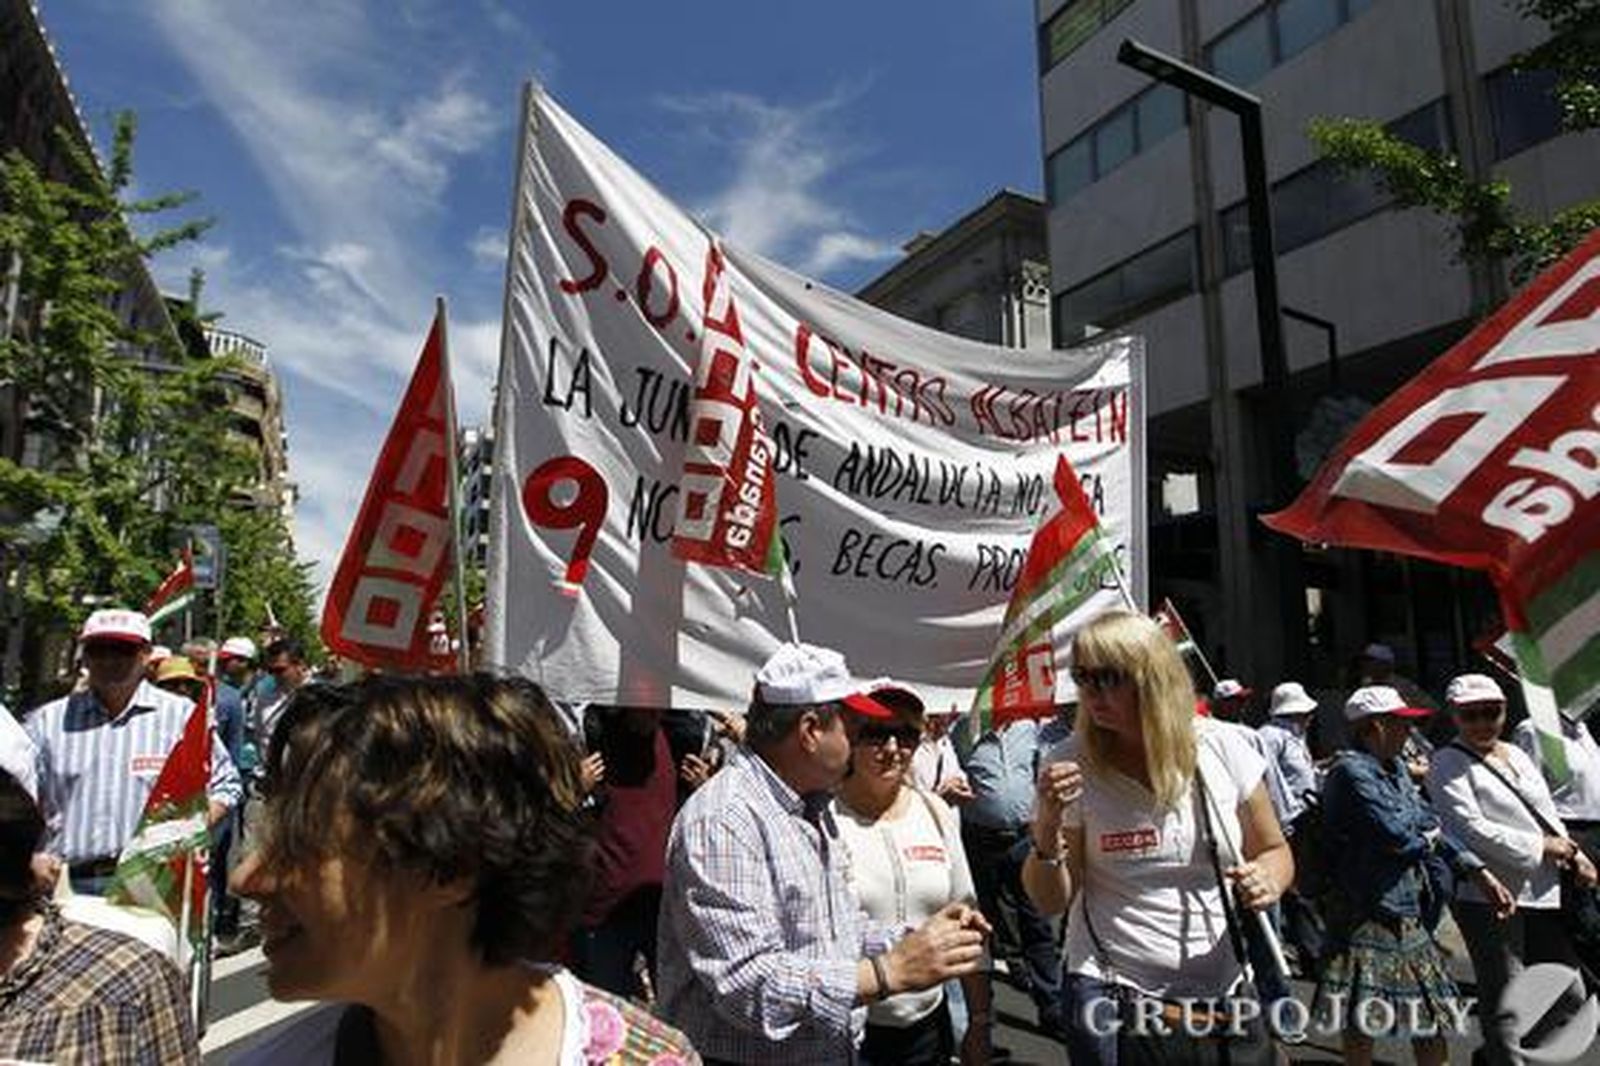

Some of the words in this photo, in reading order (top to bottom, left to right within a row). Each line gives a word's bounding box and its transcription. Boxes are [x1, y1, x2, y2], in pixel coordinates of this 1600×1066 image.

[543, 336, 592, 418] LA
[619, 366, 690, 441] JUN
[774, 422, 819, 480] DE
[522, 455, 608, 584] 9
